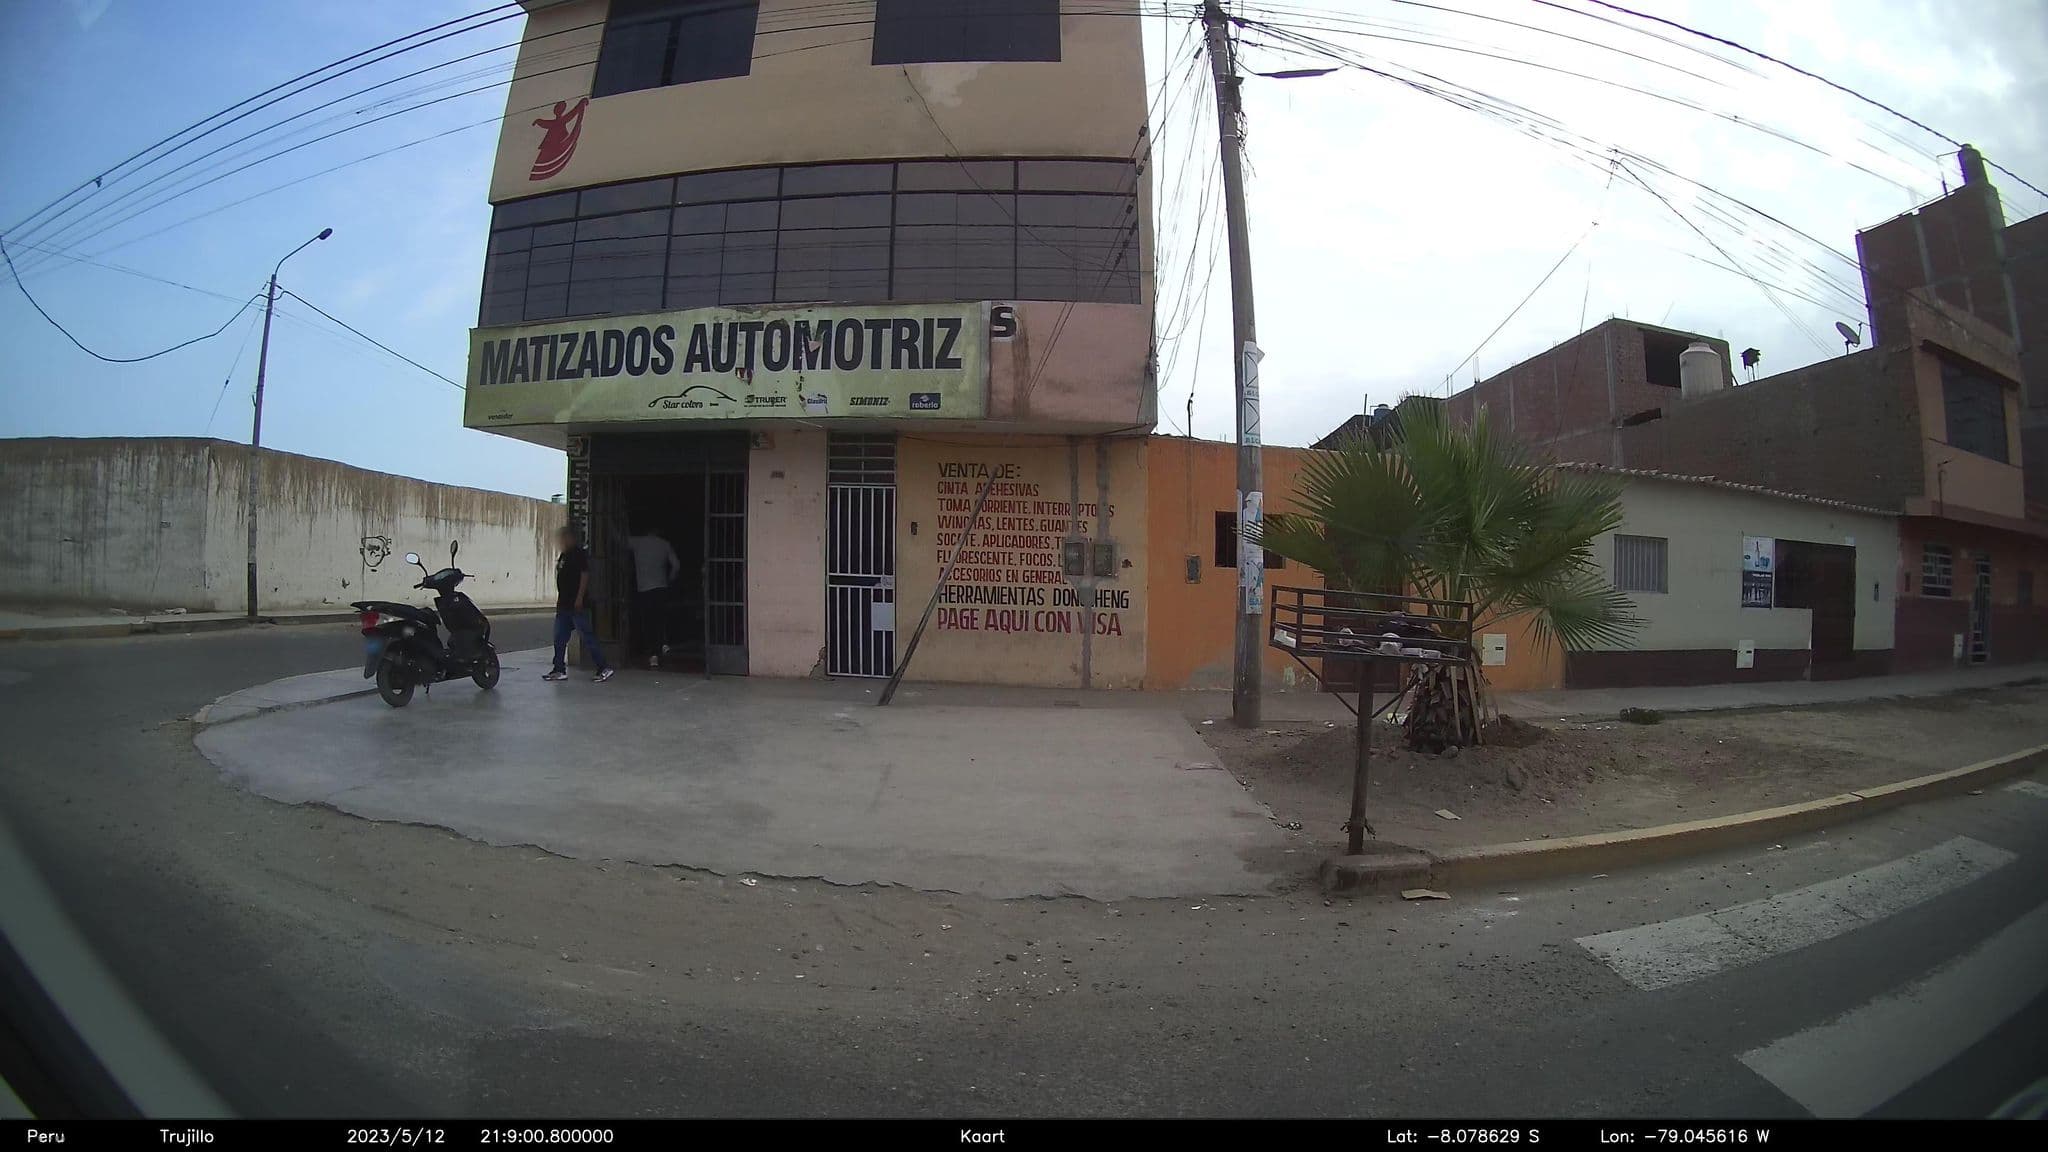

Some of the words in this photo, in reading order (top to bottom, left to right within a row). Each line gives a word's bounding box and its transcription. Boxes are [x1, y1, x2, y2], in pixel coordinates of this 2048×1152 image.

[479, 324, 676, 386] MATIZADOS
[683, 318, 962, 374] AUTOMOTRIZ
[937, 463, 990, 479] VENTA
[937, 481, 969, 495] CINTA
[975, 482, 1040, 497] AEHESIVAS
[937, 498, 972, 512] TOMA
[1006, 569, 1019, 583] EN
[938, 585, 1045, 607] HERRAMIENTAS
[937, 607, 980, 630] PAGE
[984, 609, 1030, 634] AQUI
[1034, 611, 1072, 634] CON
